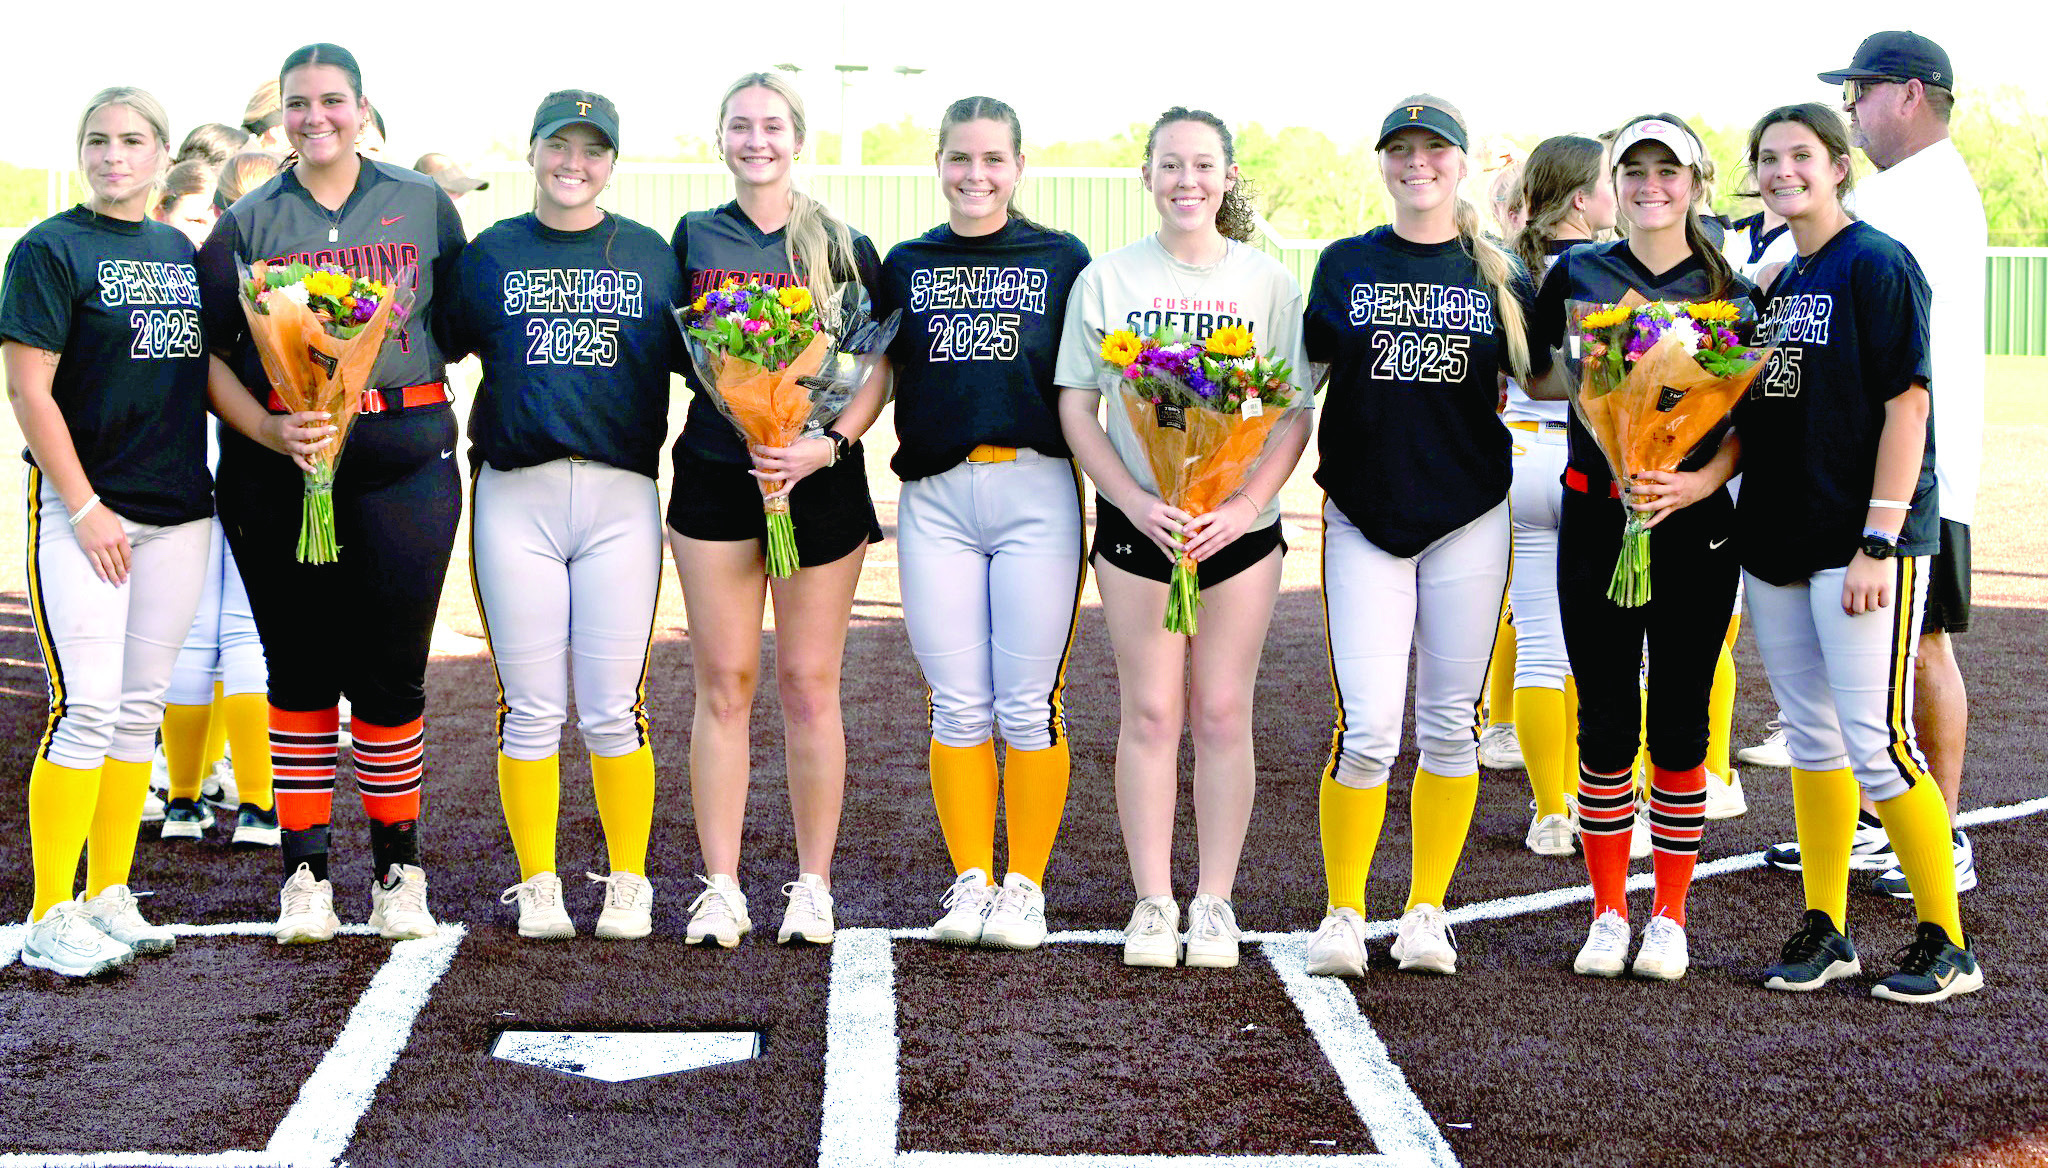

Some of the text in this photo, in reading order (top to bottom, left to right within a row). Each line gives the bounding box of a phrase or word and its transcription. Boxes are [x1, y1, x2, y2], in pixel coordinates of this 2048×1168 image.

[576, 101, 592, 117] T
[1406, 106, 1424, 120] T
[1640, 122, 1666, 134] C
[98, 260, 202, 308] SENIOR
[266, 243, 418, 291] HING
[911, 267, 1047, 315] SENIOR
[504, 269, 643, 318] SENIOR
[1153, 297, 1238, 314] CUSHING
[1350, 283, 1494, 335] SENIOR
[130, 309, 202, 359] 2025
[526, 318, 620, 367] 2025
[928, 313, 1021, 362] 2025
[1750, 294, 1833, 345] ENIOR
[1371, 330, 1471, 383] 2025
[1755, 347, 1803, 398] 25
